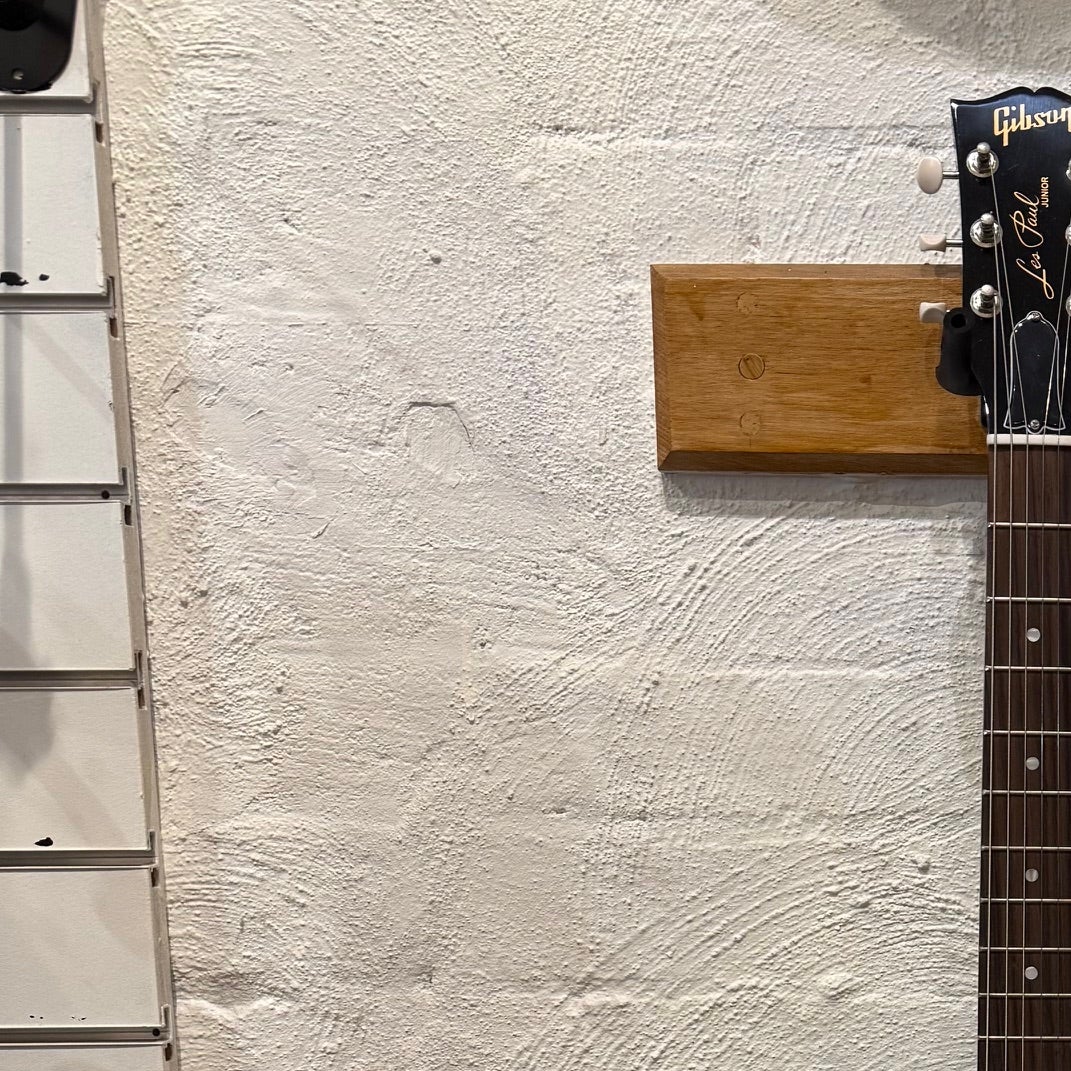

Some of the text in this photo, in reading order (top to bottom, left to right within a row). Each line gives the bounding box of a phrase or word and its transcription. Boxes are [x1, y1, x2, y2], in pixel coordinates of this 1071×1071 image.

[1040, 176, 1049, 208] JUNIOR
[1009, 191, 1055, 300] Les Paul
